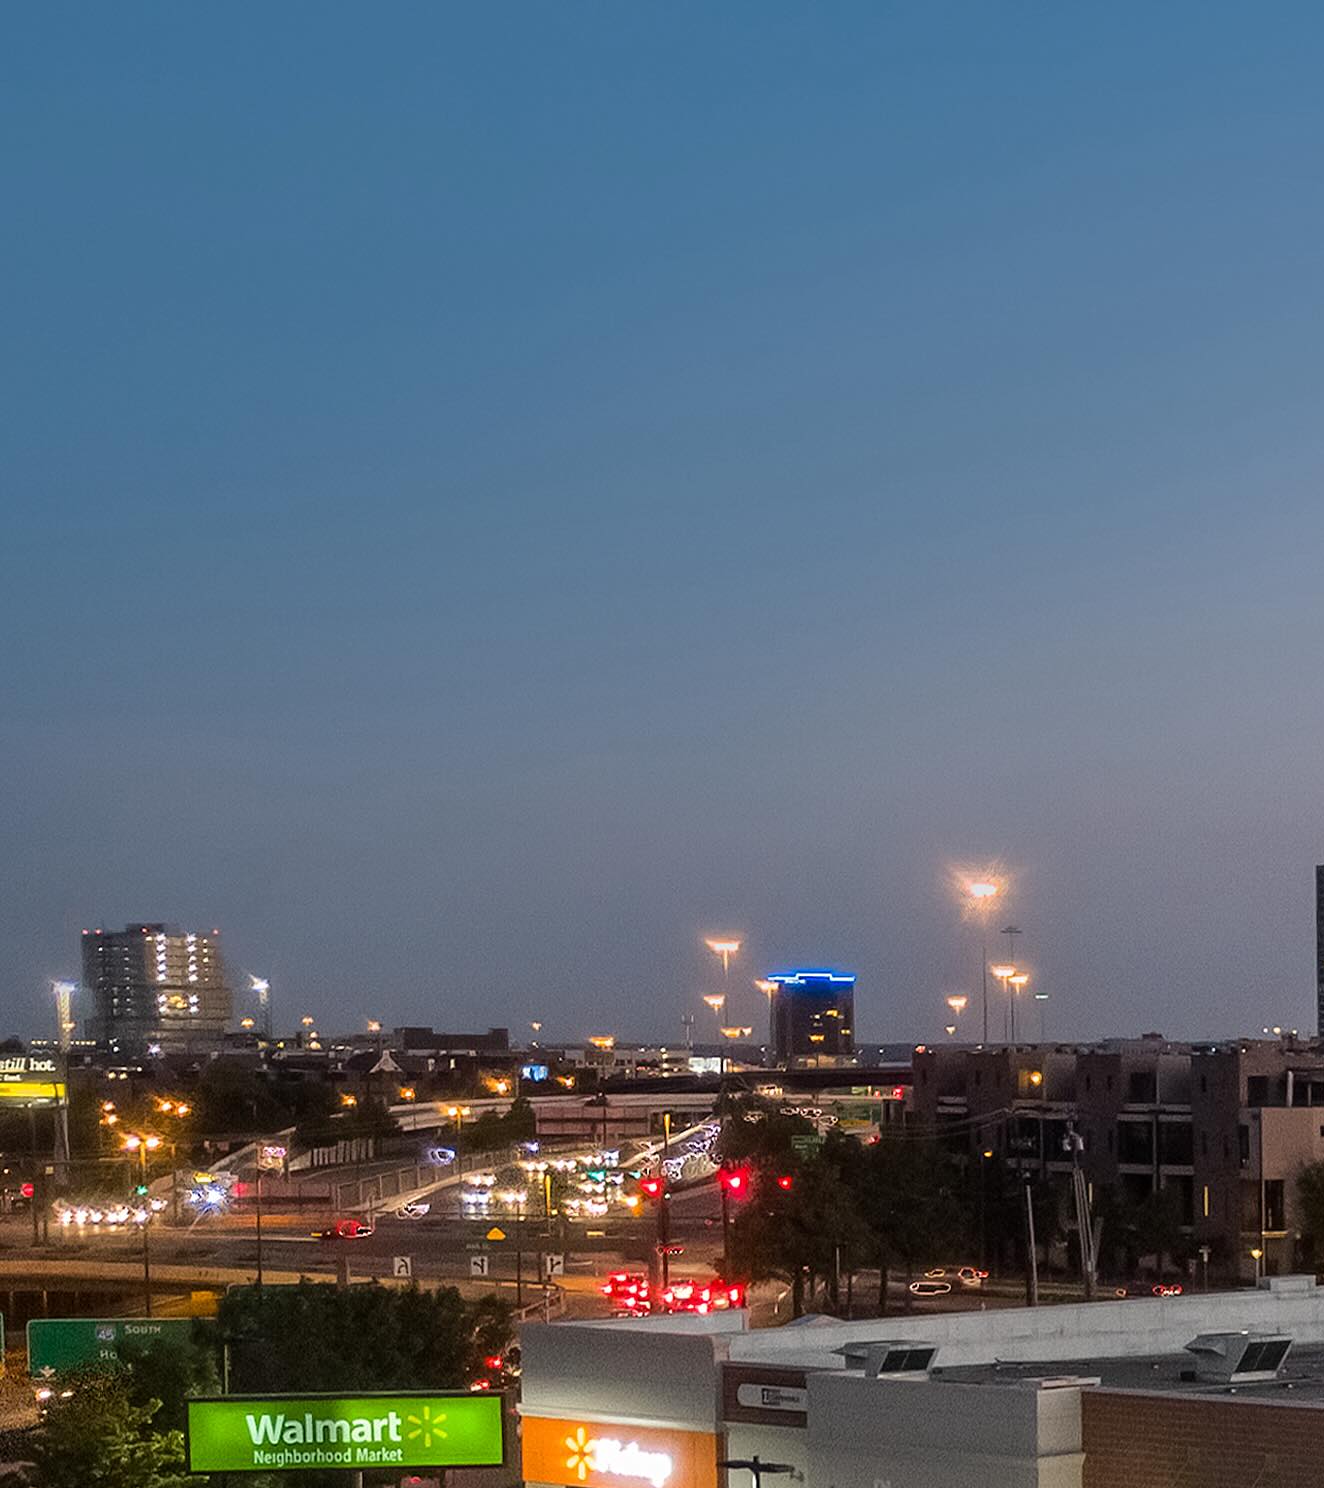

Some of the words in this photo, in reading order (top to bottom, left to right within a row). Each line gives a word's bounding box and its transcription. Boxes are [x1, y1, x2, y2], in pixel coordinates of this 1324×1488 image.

[246, 1412, 401, 1445] Walmart
[254, 1447, 352, 1467] Neighborhood
[356, 1447, 403, 1462] Market
